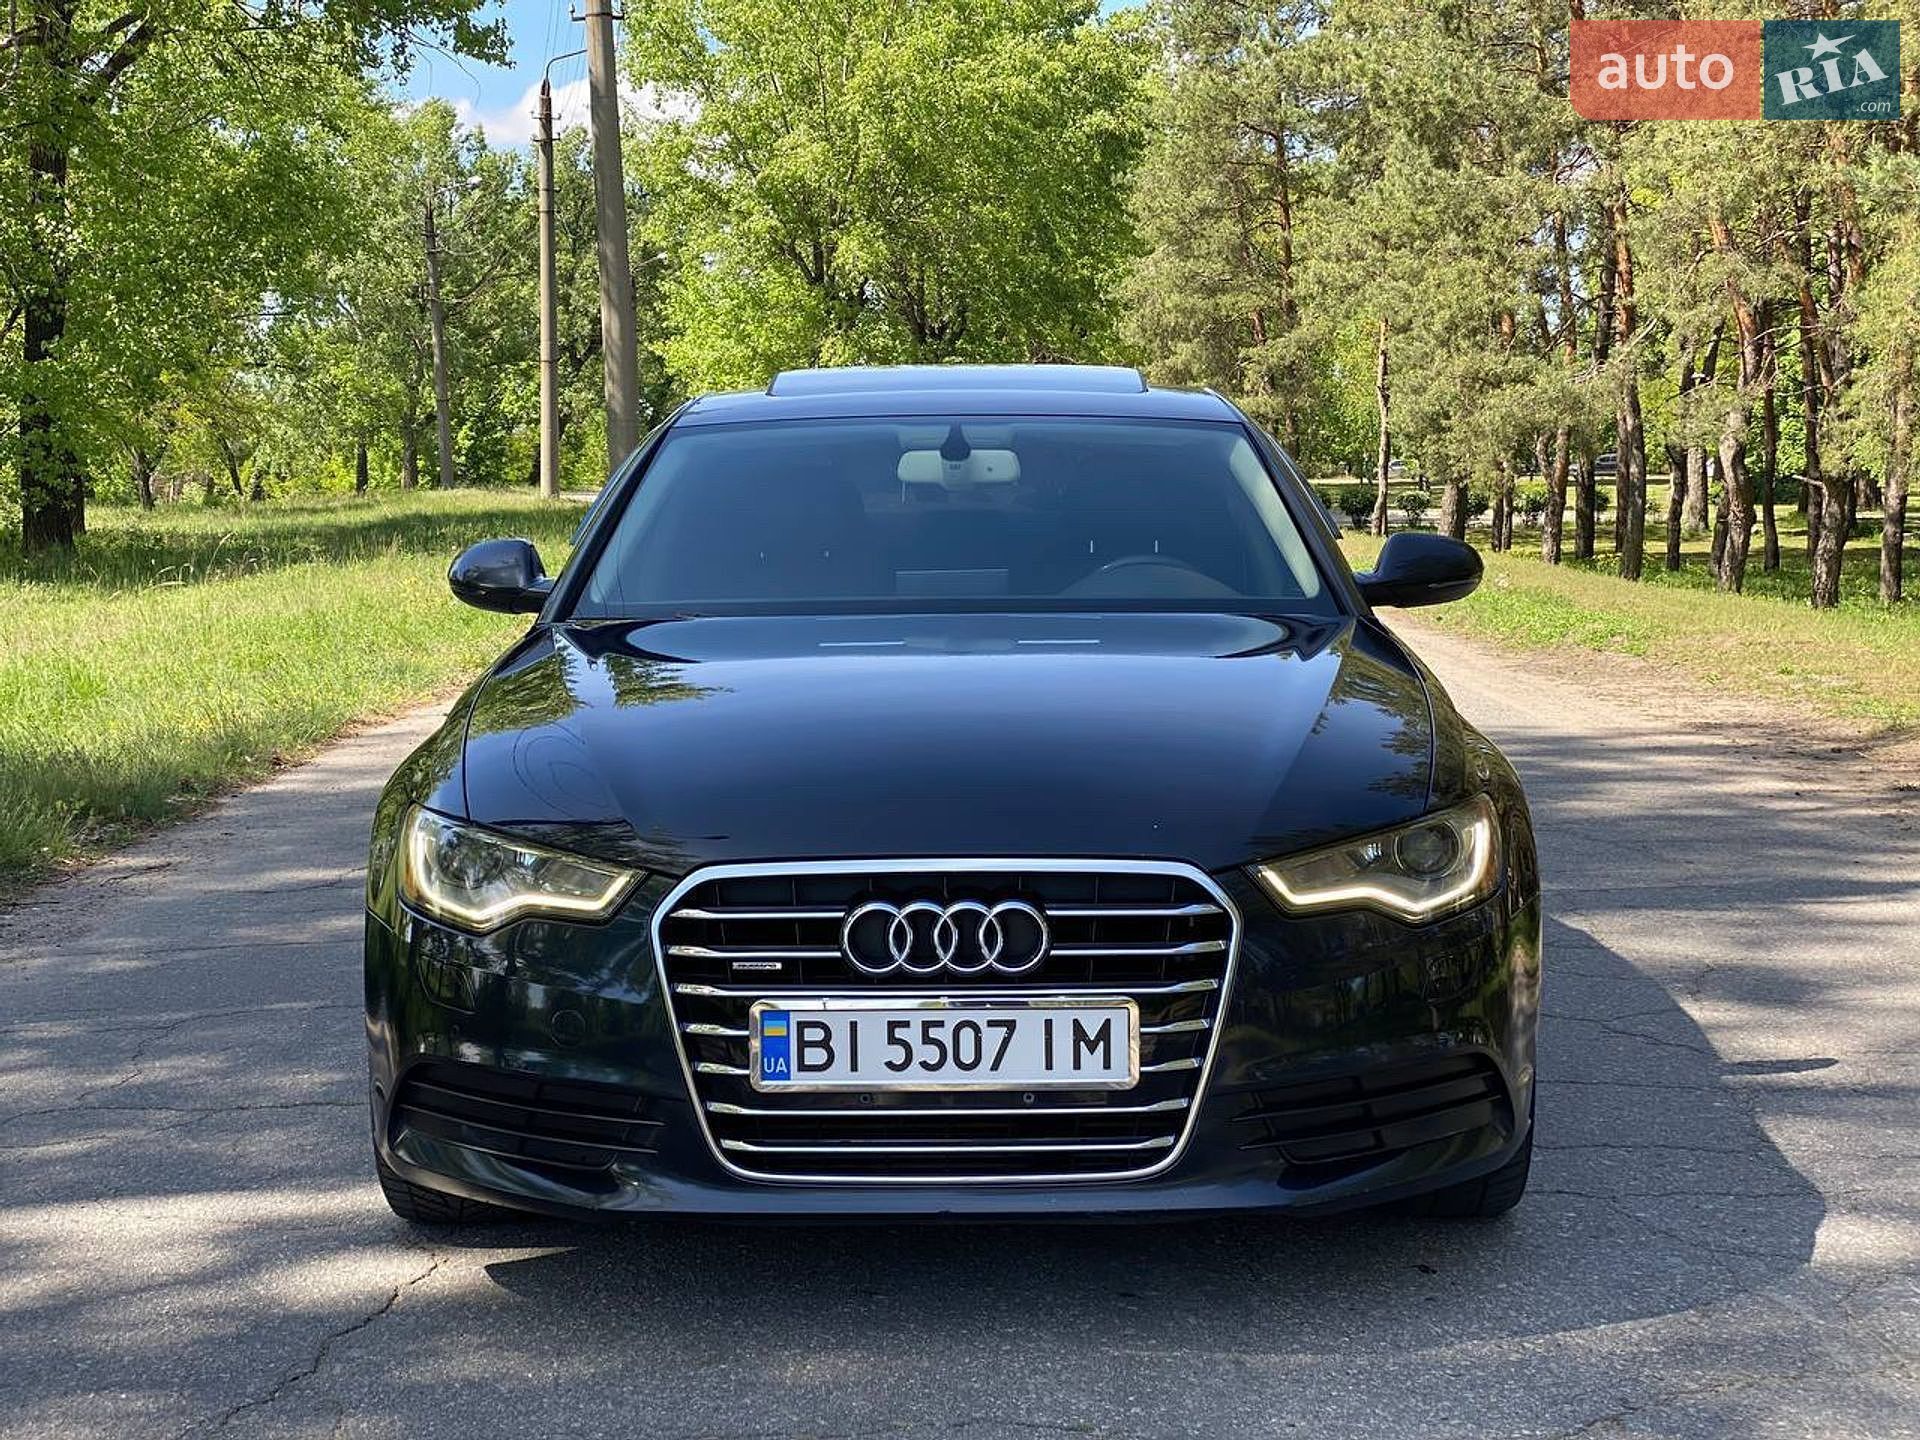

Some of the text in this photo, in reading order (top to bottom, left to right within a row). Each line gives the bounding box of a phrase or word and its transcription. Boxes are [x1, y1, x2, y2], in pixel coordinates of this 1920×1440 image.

[796, 1018, 1111, 1071] BI 5507 IM
[763, 1057, 787, 1073] UA
